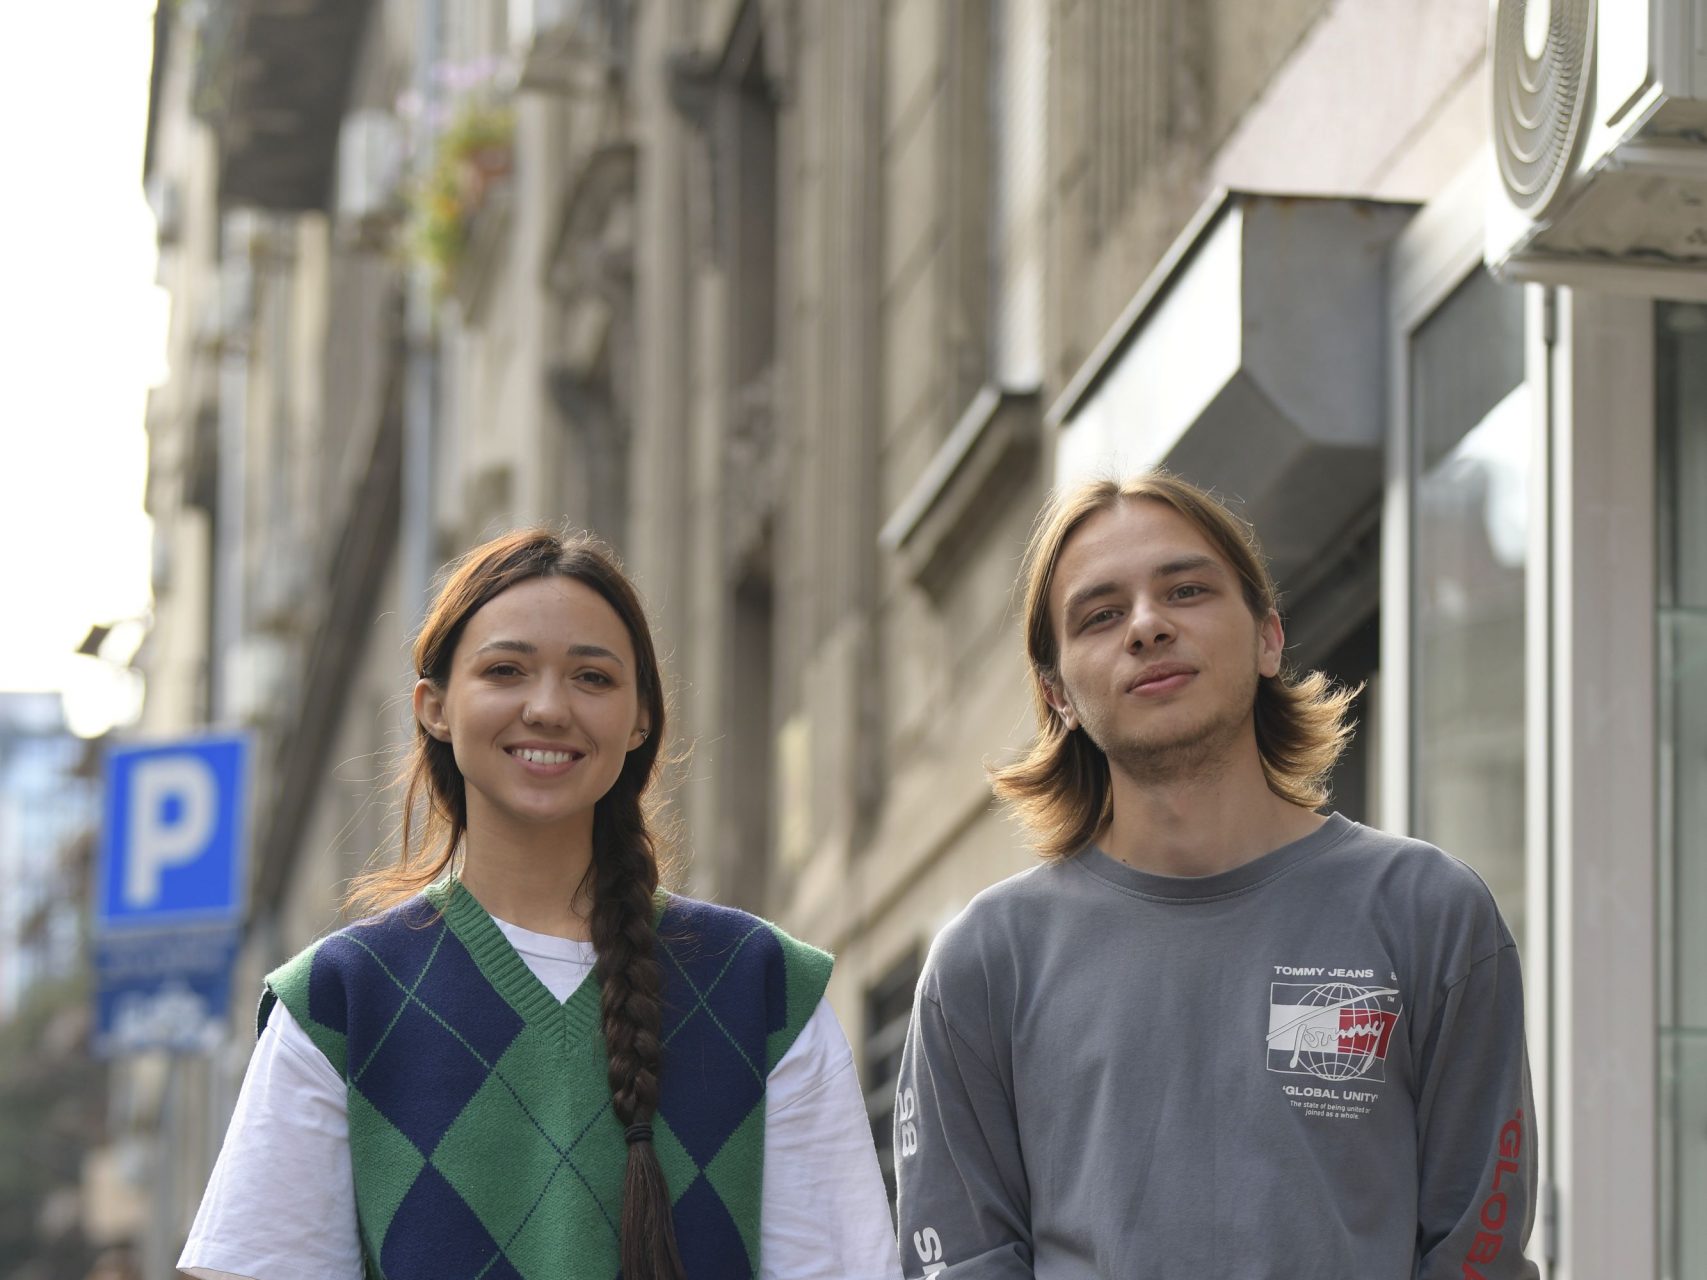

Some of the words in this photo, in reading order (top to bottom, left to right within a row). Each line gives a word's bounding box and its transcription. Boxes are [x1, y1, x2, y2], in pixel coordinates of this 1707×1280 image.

[122, 754, 219, 908] P
[1274, 965, 1325, 977] TOMMY
[1328, 968, 1374, 978] JEANS
[1303, 1101, 1319, 1109] state
[1327, 1104, 1346, 1112] being
[1346, 1106, 1364, 1114] united
[1305, 1109, 1325, 1117] joined
